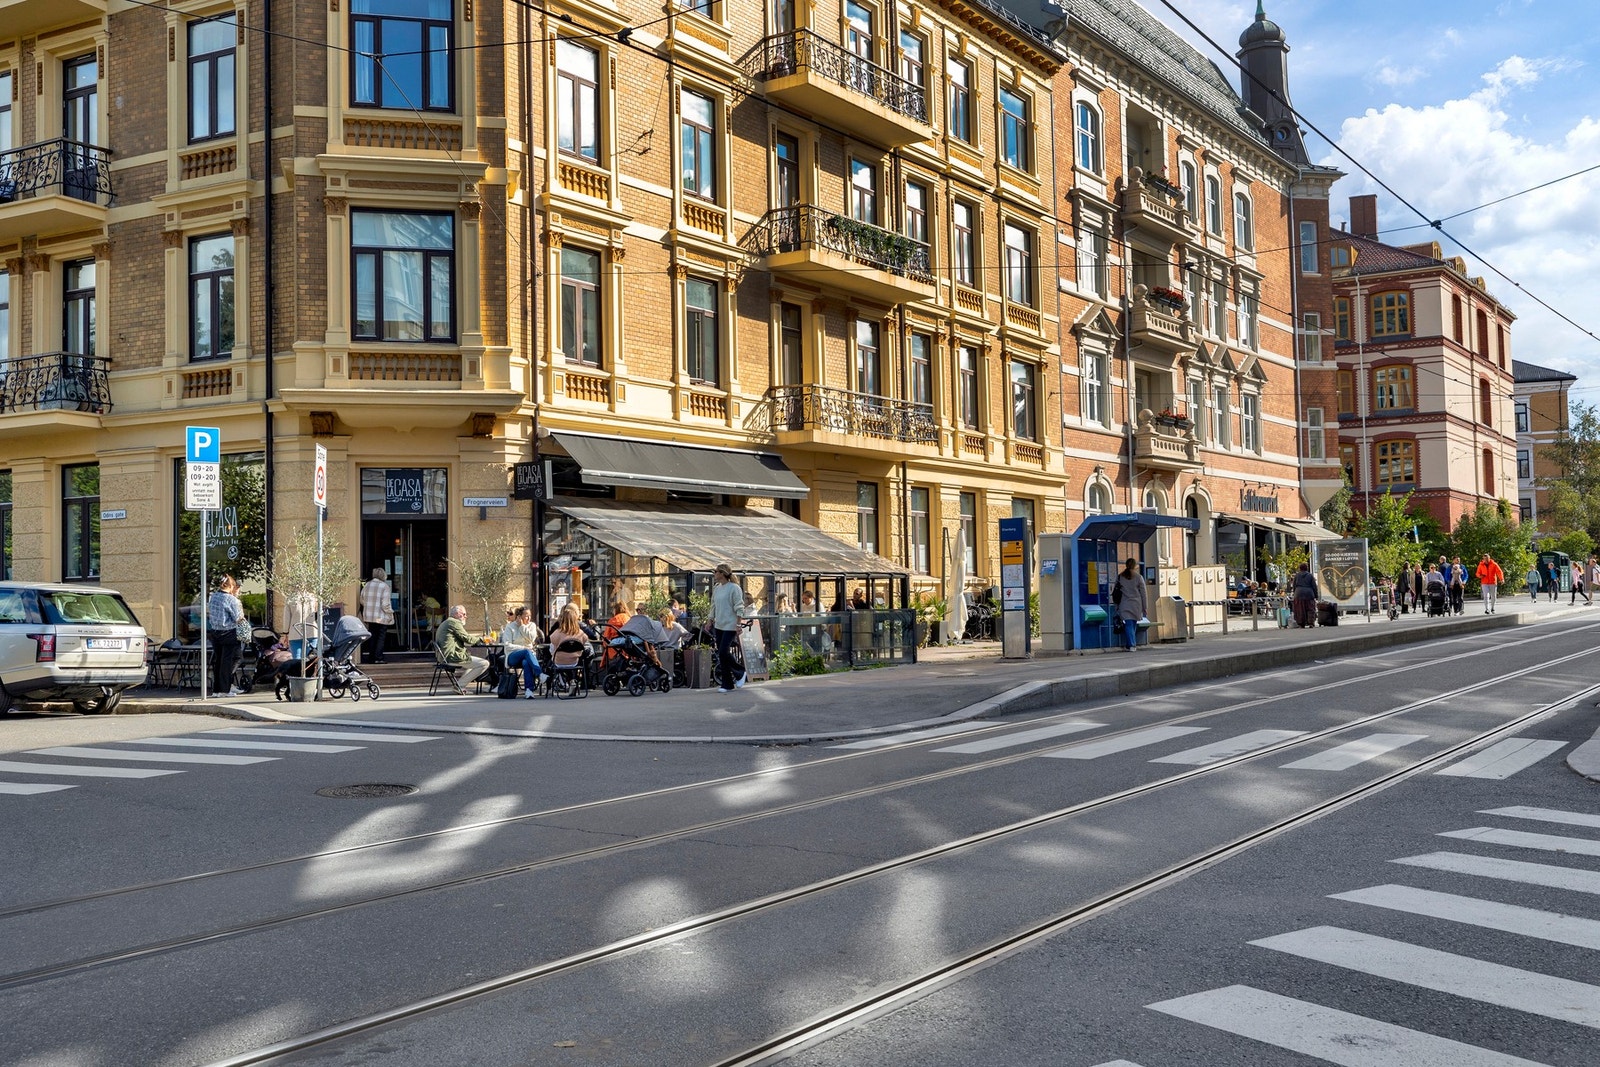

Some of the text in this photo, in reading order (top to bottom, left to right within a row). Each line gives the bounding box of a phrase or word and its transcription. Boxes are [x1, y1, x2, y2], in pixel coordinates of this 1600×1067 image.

[194, 431, 212, 458] P
[386, 478, 394, 487] DE
[522, 465, 543, 484] CASA
[386, 486, 394, 497] LA
[394, 478, 422, 497] CASA
[467, 498, 504, 506] Frognerveien
[211, 507, 238, 537] CASA
